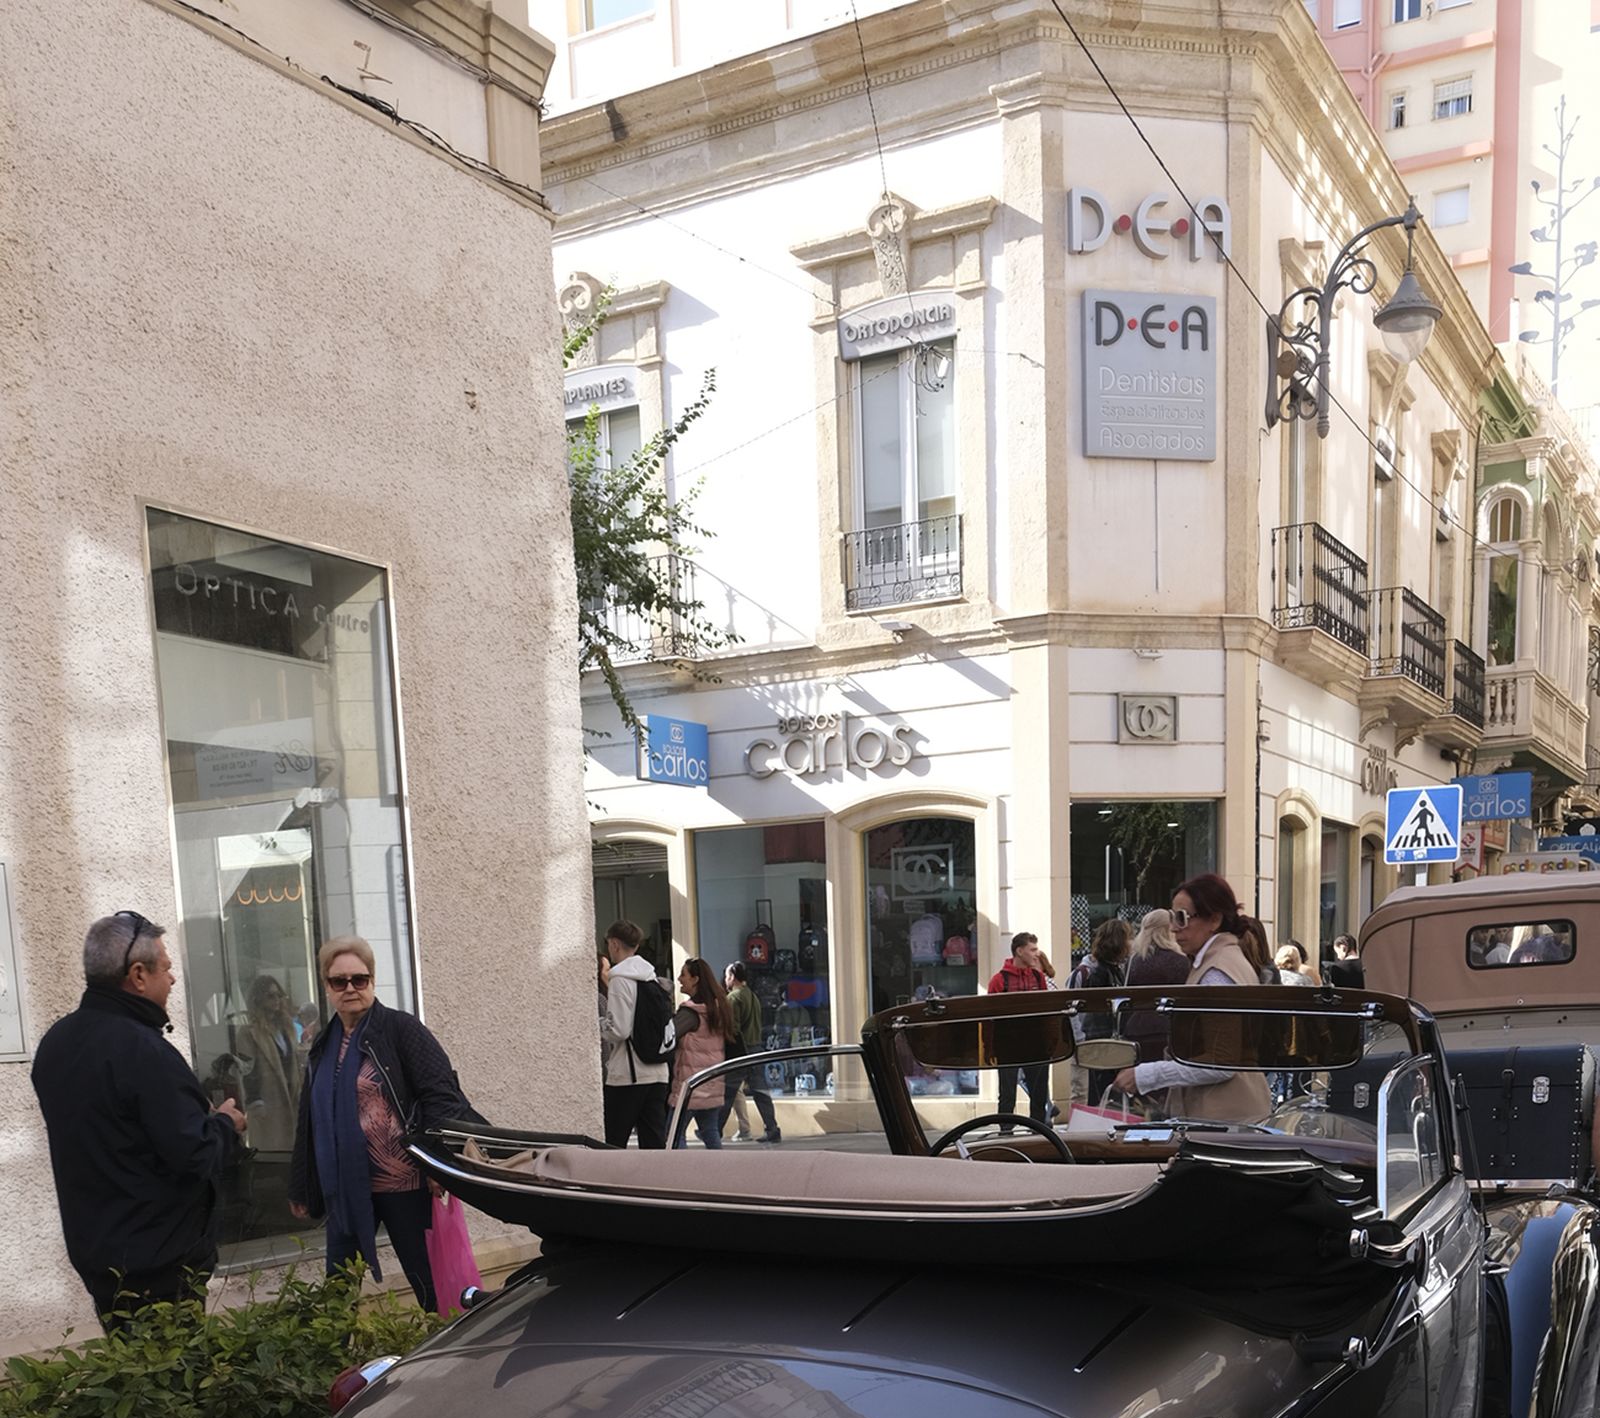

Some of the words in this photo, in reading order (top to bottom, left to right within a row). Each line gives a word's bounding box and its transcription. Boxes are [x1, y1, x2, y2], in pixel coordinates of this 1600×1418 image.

[845, 304, 952, 342] ORTODONCIA
[564, 377, 626, 405] PLANTES
[1099, 366, 1205, 396] Dentistas
[1100, 401, 1206, 422] Especializados
[1100, 426, 1206, 452] Asociados
[778, 712, 840, 735] BOLSOS
[743, 710, 913, 781] carlos
[650, 747, 707, 781] carlos
